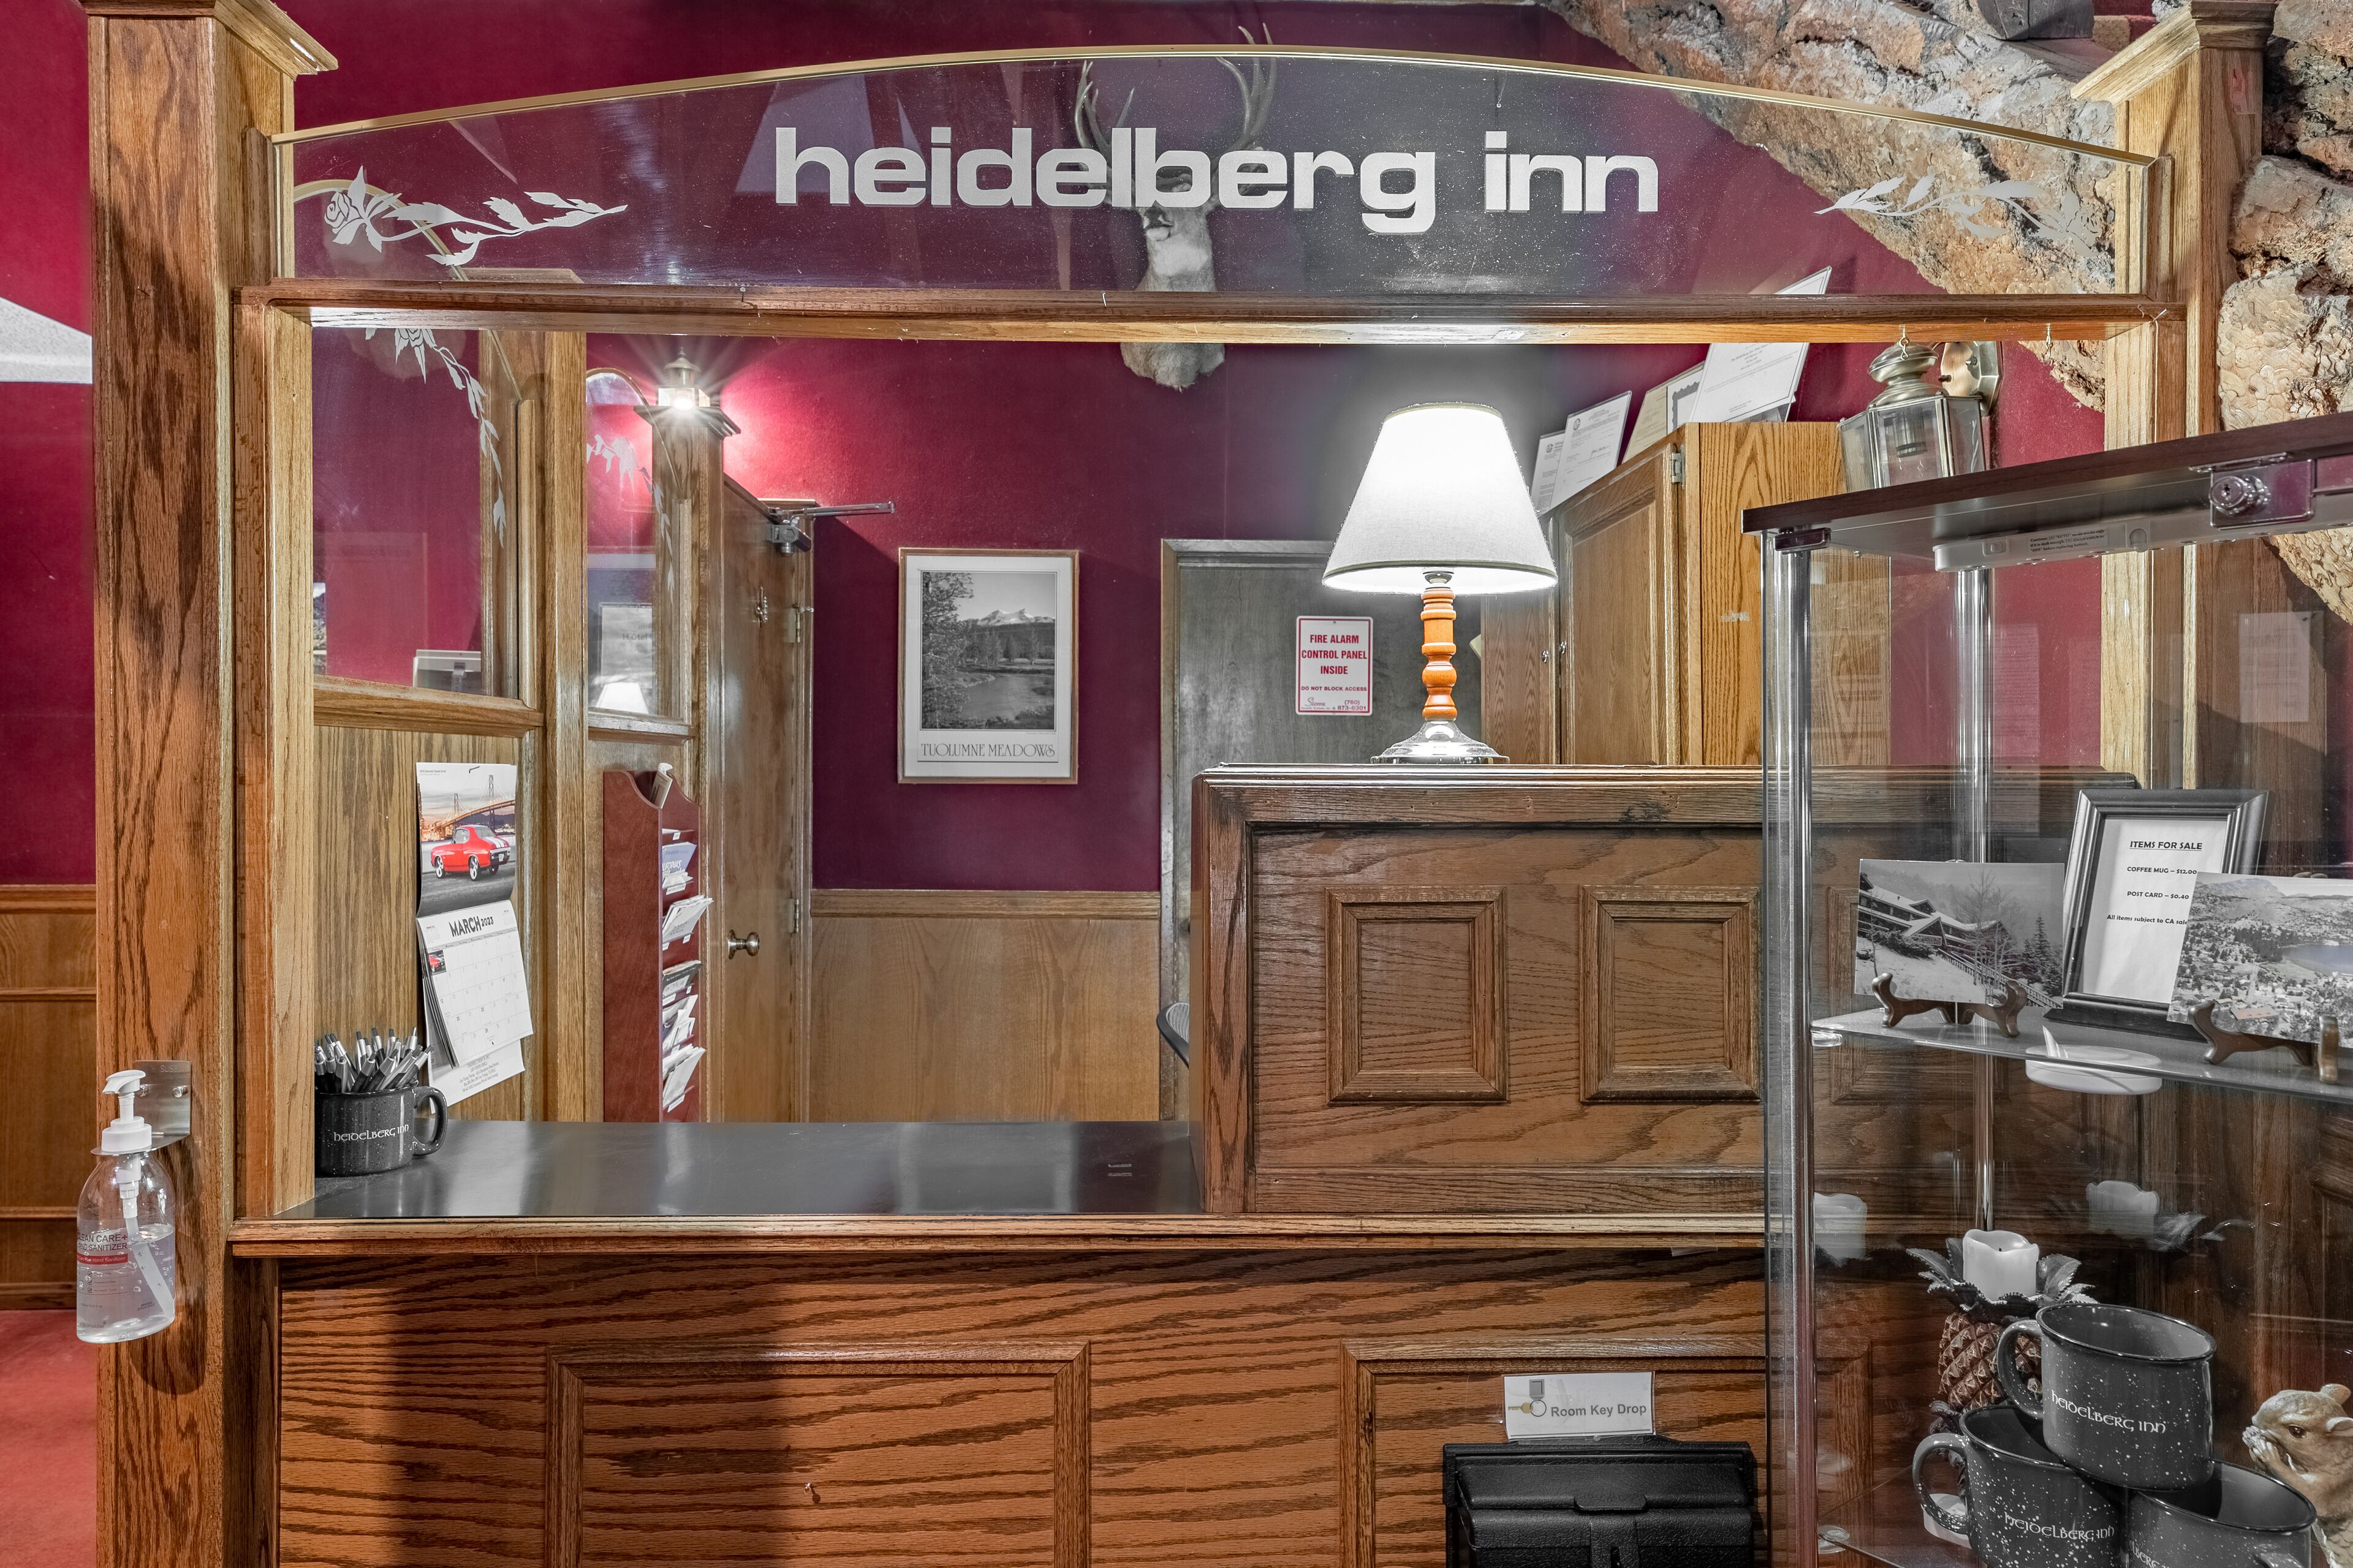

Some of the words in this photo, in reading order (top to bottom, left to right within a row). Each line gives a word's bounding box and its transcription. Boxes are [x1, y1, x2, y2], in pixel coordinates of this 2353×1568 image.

[776, 126, 1436, 234] heidelberg
[1485, 131, 1658, 212] inn
[1310, 635, 1327, 643] FIRE
[1330, 635, 1359, 643] ALARM
[1302, 650, 1338, 659] CONTROL
[1341, 650, 1367, 659] PANEL
[1320, 665, 1348, 675] INSIDE
[922, 743, 985, 756] TUOLUMNE
[988, 744, 1055, 757] MEADOWS
[449, 916, 482, 937] MARCH
[480, 917, 494, 927] 2023
[96, 1234, 127, 1243] CARE+
[89, 1243, 128, 1251] SANITIZER
[1551, 1406, 1586, 1417] Room
[1591, 1404, 1613, 1417] Key
[1618, 1404, 1646, 1416] Drop
